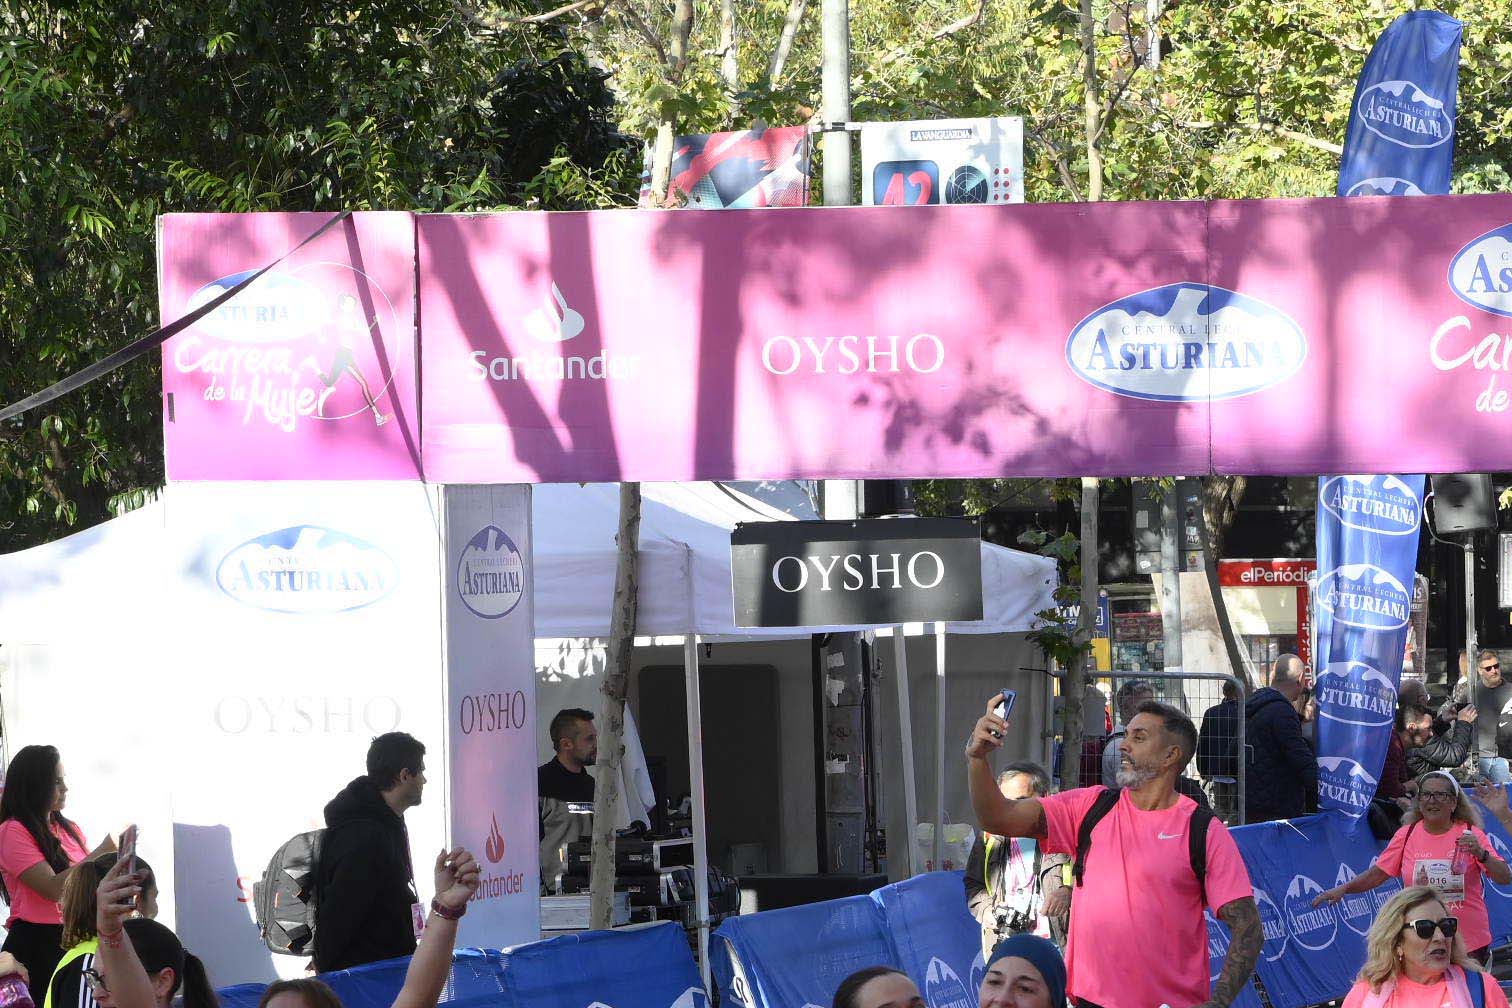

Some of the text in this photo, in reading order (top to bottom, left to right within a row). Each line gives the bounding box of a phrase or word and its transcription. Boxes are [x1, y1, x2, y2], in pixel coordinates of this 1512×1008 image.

[1364, 95, 1444, 139] ASTURIANA
[1085, 327, 1286, 371] ASTURIANA
[1121, 323, 1197, 335] CENTRAL
[174, 336, 293, 374] Carrera
[467, 348, 640, 382] Santander
[760, 332, 946, 377] OYSHO
[204, 375, 226, 401] de
[243, 370, 337, 433] Mujer
[1475, 381, 1512, 413] de
[1329, 485, 1416, 527] ASTURIANA
[231, 559, 386, 593] ASTURIANA
[463, 561, 521, 597] ASTURIANA
[771, 551, 945, 593] OYSHO
[1326, 581, 1406, 621] ASTURIANA
[212, 695, 402, 736] OYSHO
[459, 689, 526, 736] OYSHO
